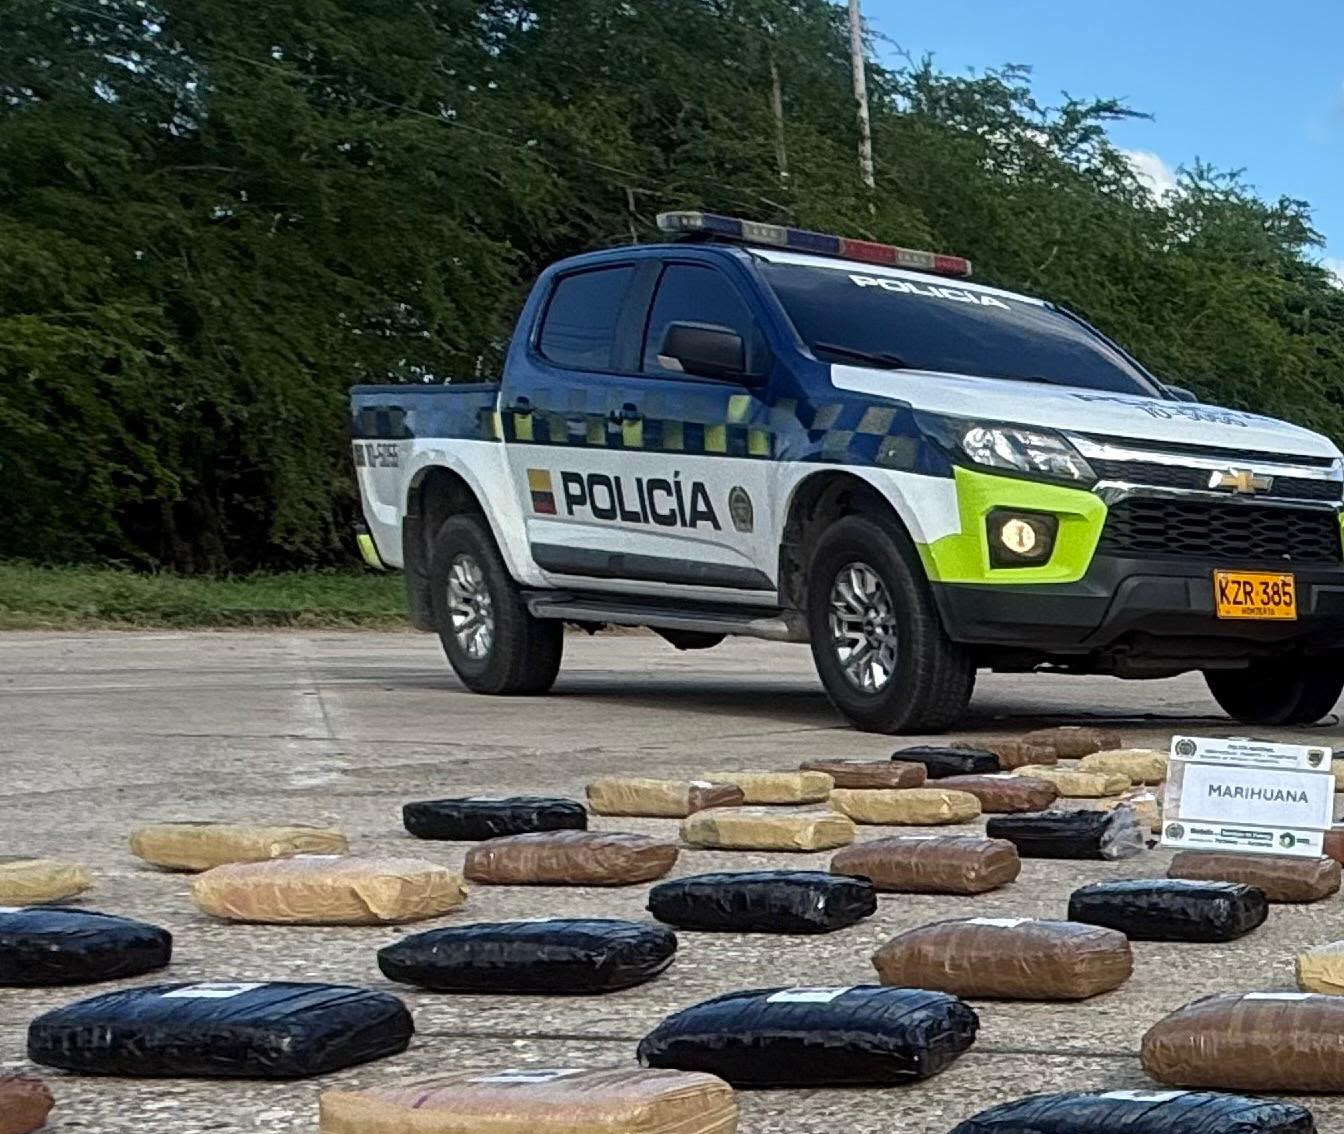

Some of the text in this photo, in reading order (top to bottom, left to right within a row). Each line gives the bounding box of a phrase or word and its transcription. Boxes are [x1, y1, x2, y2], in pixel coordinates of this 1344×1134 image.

[560, 470, 722, 531] POLICÍA
[1219, 578, 1293, 607] KZR 385
[1208, 784, 1309, 804] MARIHUANA
